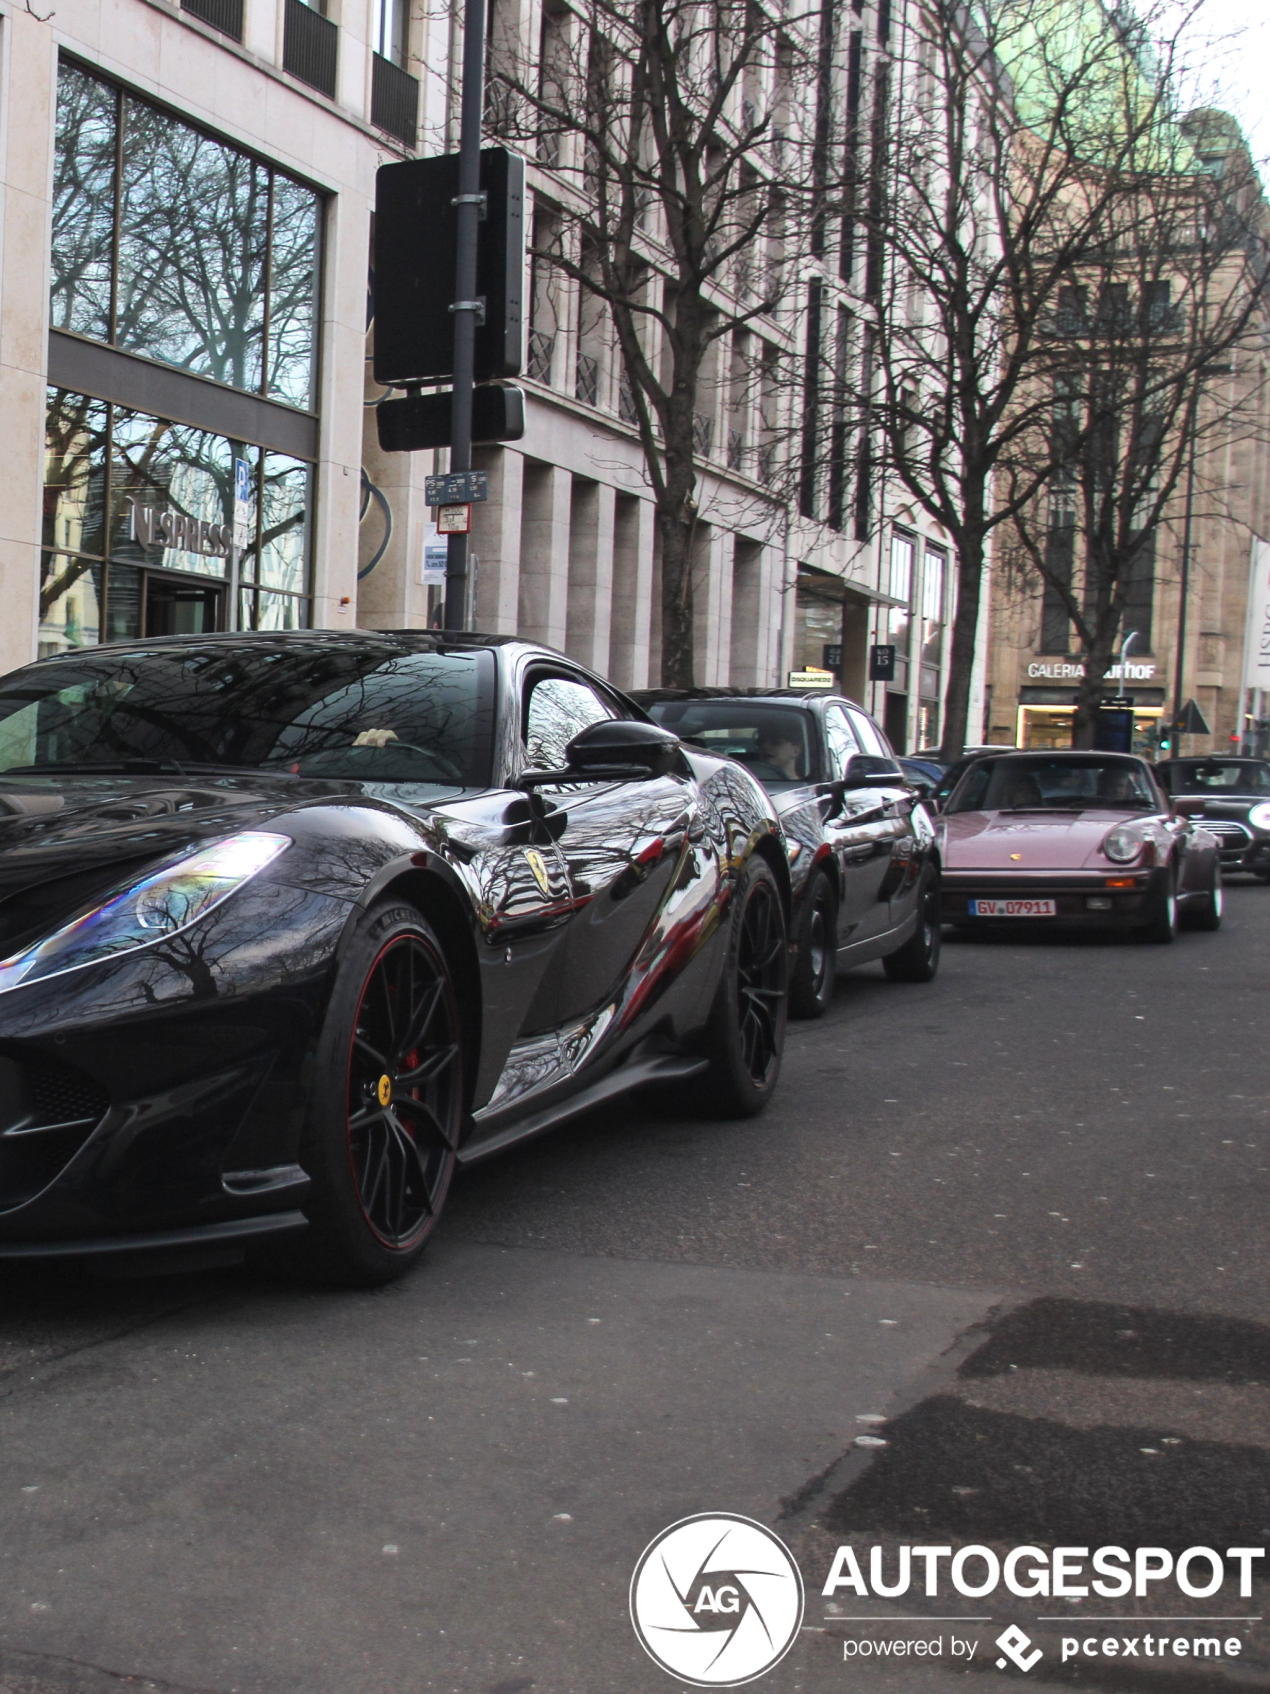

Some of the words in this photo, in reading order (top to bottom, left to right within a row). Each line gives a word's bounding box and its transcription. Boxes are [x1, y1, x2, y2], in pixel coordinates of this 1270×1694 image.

[126, 495, 244, 558] NESPRESS
[1028, 663, 1085, 678] GALERIA
[977, 901, 996, 914] GV
[1005, 901, 1052, 914] 07911
